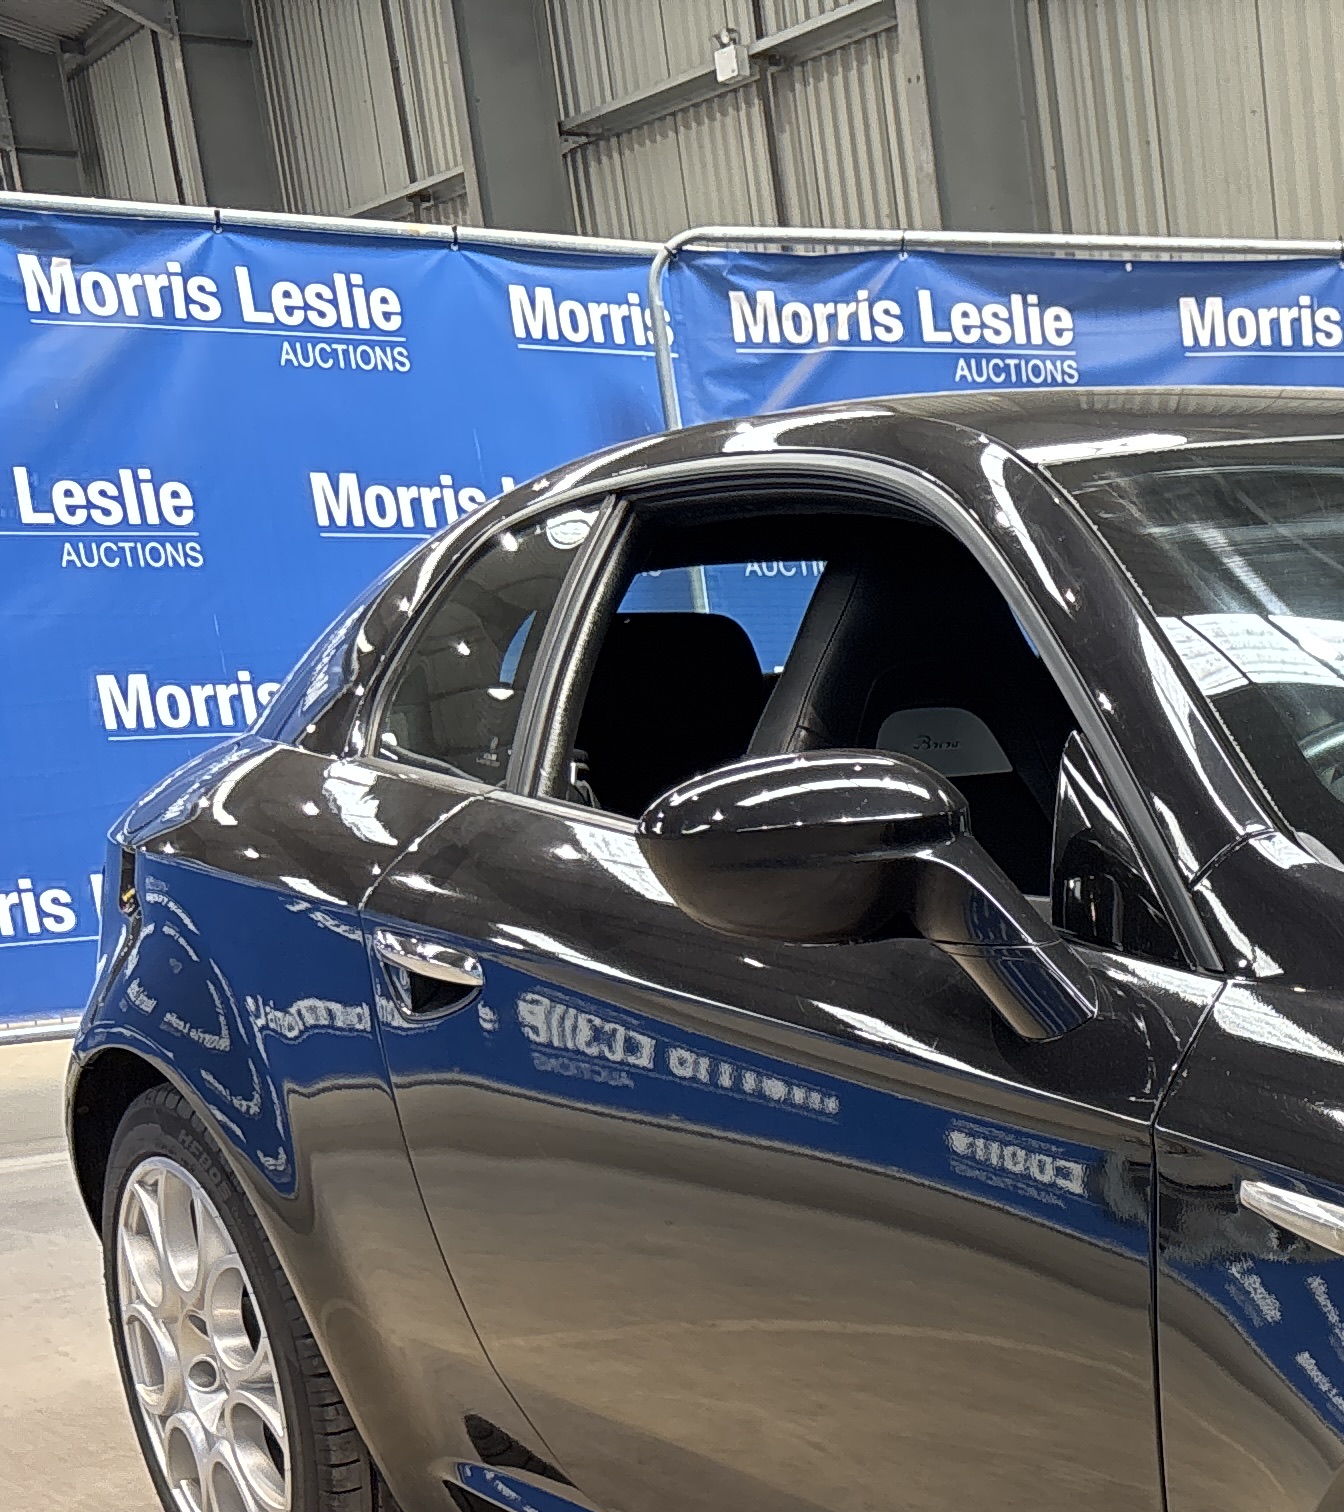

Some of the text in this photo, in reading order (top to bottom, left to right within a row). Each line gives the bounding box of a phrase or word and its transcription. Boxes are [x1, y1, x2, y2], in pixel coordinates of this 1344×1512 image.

[16, 253, 402, 332] Morris Leslie
[728, 289, 1074, 347] Morris Leslie
[1179, 295, 1343, 348] Morris
[280, 341, 411, 372] AUCTIONS
[954, 357, 1079, 385] AUCTIONS
[12, 466, 194, 526] Leslie
[309, 471, 487, 529] Morris
[61, 541, 204, 568] AUCTIONS
[0, 878, 77, 936] ris
